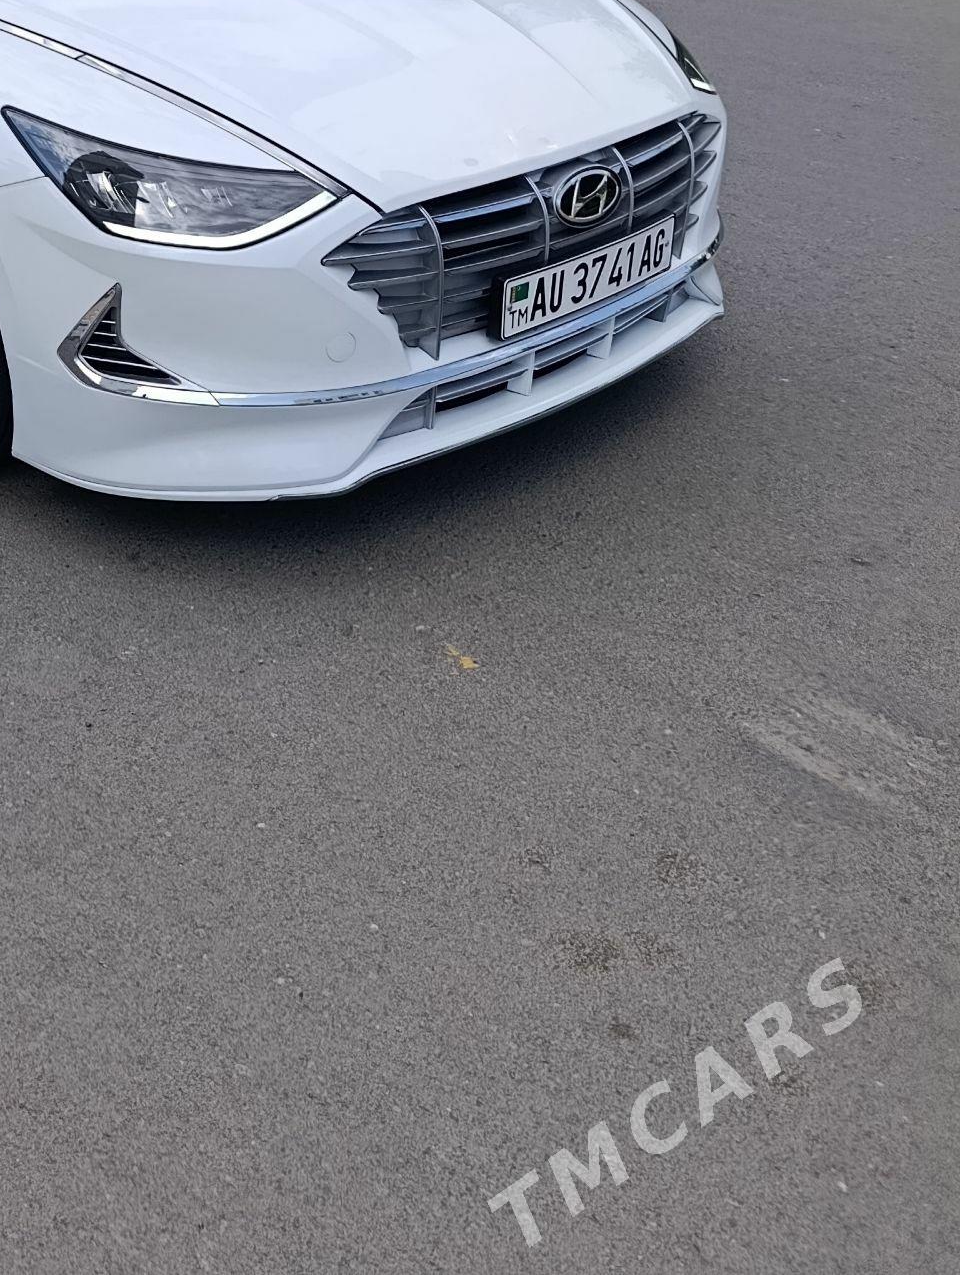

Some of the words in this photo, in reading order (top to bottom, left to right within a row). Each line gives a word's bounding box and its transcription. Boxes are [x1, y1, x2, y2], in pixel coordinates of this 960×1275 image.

[509, 306, 528, 328] TM
[530, 270, 565, 321] AU
[571, 242, 635, 304] 3741
[638, 228, 665, 276] AG
